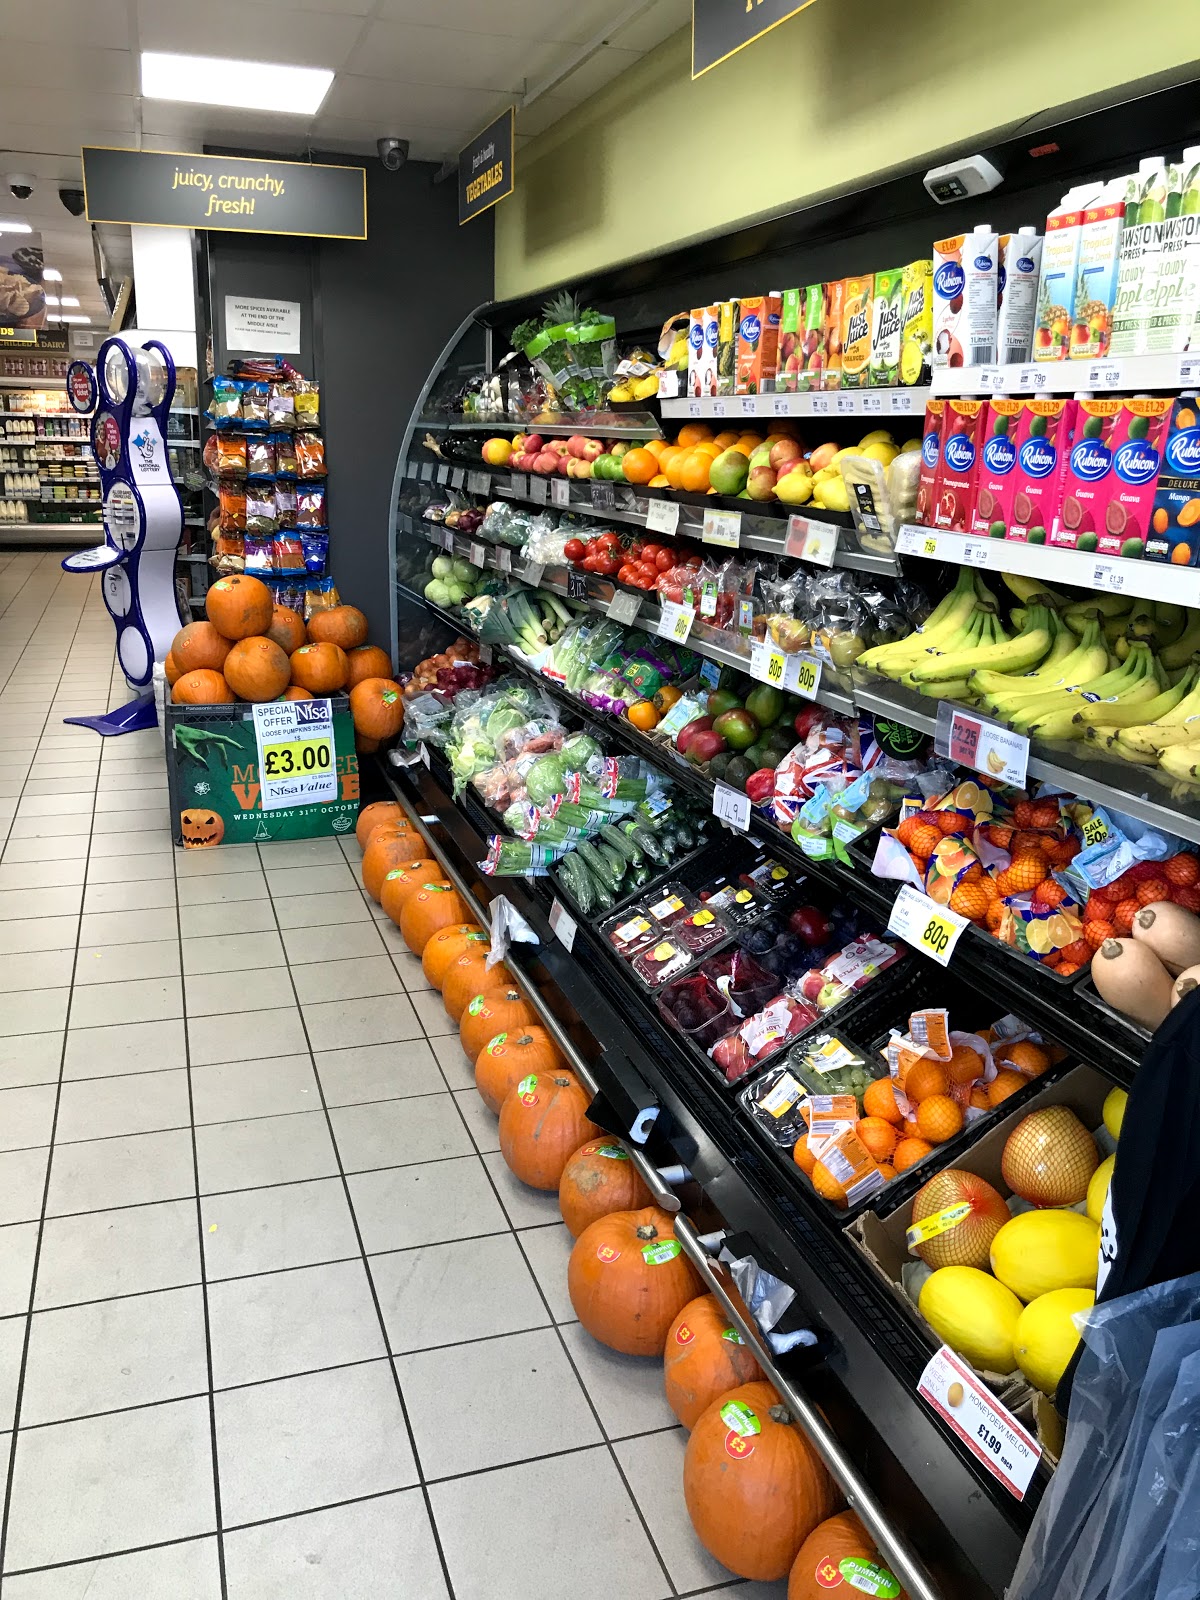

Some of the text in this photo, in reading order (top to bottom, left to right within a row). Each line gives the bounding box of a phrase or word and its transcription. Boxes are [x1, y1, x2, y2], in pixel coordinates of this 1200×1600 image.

[172, 168, 285, 196] juicy, crunchy,
[466, 160, 503, 204] VEGETABLES
[205, 195, 254, 216] fresh!
[1104, 207, 1116, 217] 79p
[1049, 218, 1060, 228] 79p
[1065, 215, 1075, 225] 79p
[1087, 211, 1098, 221] 79p
[942, 240, 956, 252] £1.69
[1046, 241, 1074, 257] Tropical
[1083, 233, 1113, 250] Tropical
[1163, 240, 1183, 253] PRESS
[1124, 247, 1140, 260] PRESS
[938, 271, 962, 289] Rubicon
[880, 304, 898, 325] Just
[873, 318, 900, 350] Juice
[1034, 373, 1046, 384] 79p
[965, 401, 976, 412] £1.29
[1007, 402, 1020, 412] £1.29
[1043, 402, 1059, 412] £1.29
[1100, 403, 1118, 413] £1.29
[1145, 402, 1165, 413] £1.29
[948, 442, 972, 460] Rubicon
[986, 444, 1013, 462] Rubicon
[1022, 446, 1053, 466] Rubicon
[1074, 448, 1108, 468] Rubicon
[1118, 450, 1155, 471] Rubicon
[943, 478, 969, 489] Pomegranate
[989, 482, 1003, 490] Guava
[1025, 485, 1042, 495] Guava
[1168, 480, 1198, 489] DELUXE
[1076, 489, 1094, 499] Guava
[1120, 492, 1140, 503] Guava
[1168, 493, 1190, 503] Mango
[924, 542, 935, 553] 75p
[675, 619, 687, 638] 80p
[768, 658, 782, 682] 80p
[798, 666, 814, 691] 80p
[257, 703, 329, 722] SPECIAL Nisa
[263, 717, 293, 727] OFFER
[282, 727, 312, 735] PUMPKINS
[983, 730, 1023, 750] LOOSE BANANAS
[265, 745, 330, 775] £3.00
[270, 786, 298, 797] Nisa
[299, 781, 332, 792] Value
[234, 810, 295, 820] WEDNESDAY
[321, 802, 360, 814] OCTOBE
[1084, 819, 1103, 834] SALE
[1086, 831, 1107, 846] 50p
[923, 920, 948, 953] 80p
[601, 1247, 614, 1258] £3
[934, 1357, 948, 1373] ONE
[929, 1365, 947, 1386] WEEK
[923, 1376, 940, 1393] ONLY
[729, 1404, 756, 1434] PUMPKIN
[969, 1393, 1030, 1458] HONEYDEW MELON
[730, 1437, 746, 1453] £3
[976, 1424, 1013, 1470] £1.99 each
[820, 1564, 836, 1581] £3
[848, 1561, 892, 1588] PUMPKIN
